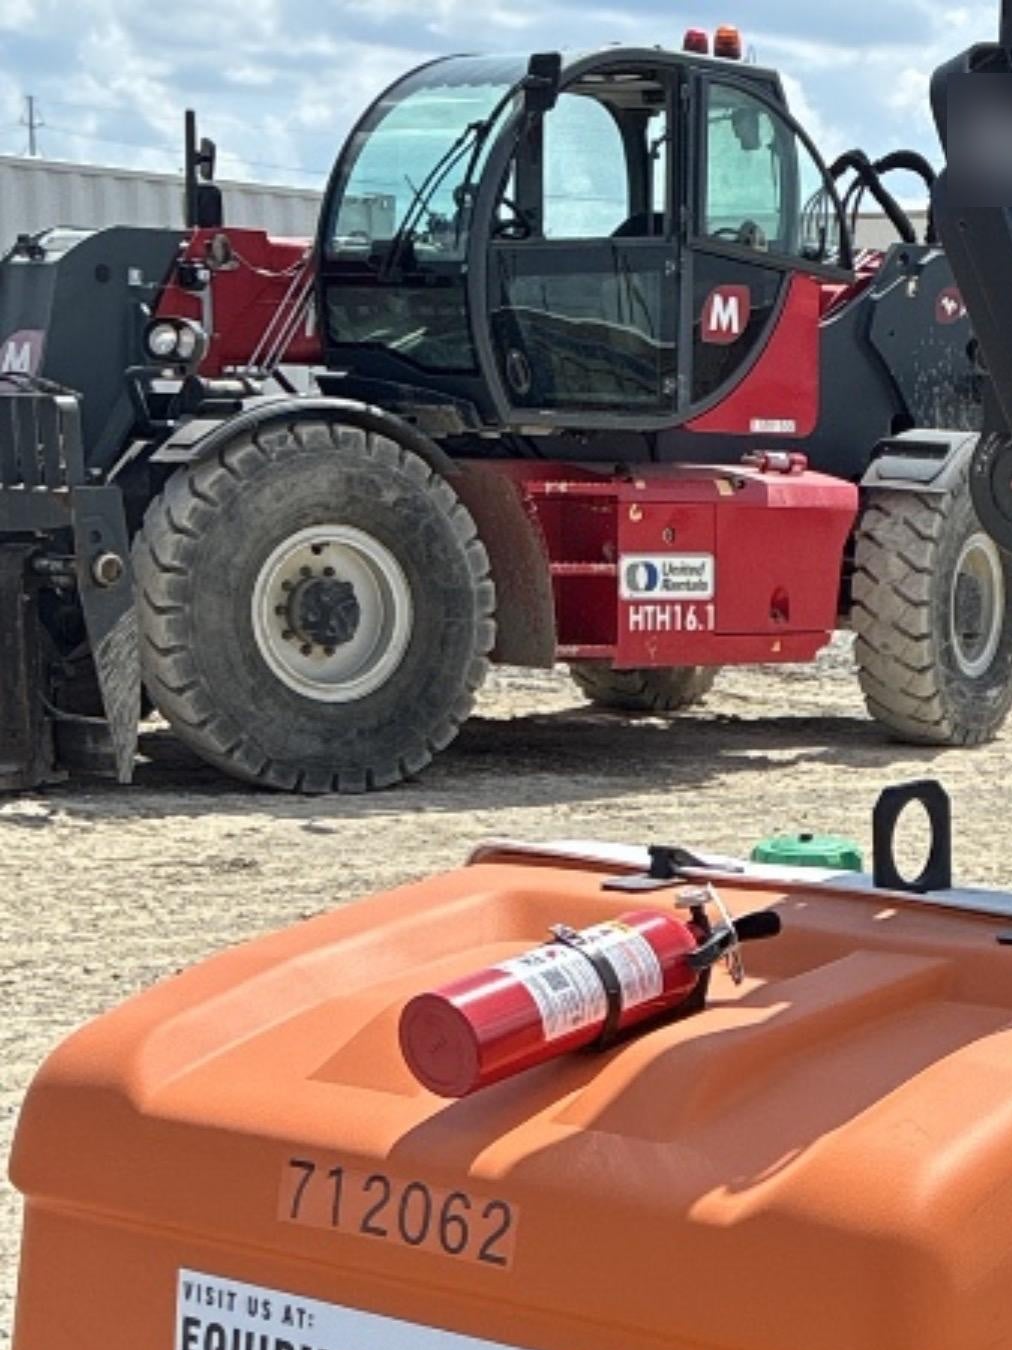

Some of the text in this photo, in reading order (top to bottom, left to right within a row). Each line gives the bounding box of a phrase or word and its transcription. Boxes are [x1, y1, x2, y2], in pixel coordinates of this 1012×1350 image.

[708, 293, 740, 334] M
[1, 341, 31, 373] M
[628, 603, 715, 631] HTH16.1
[287, 1159, 513, 1267] 712062
[182, 1281, 316, 1329] VISIT US AT:
